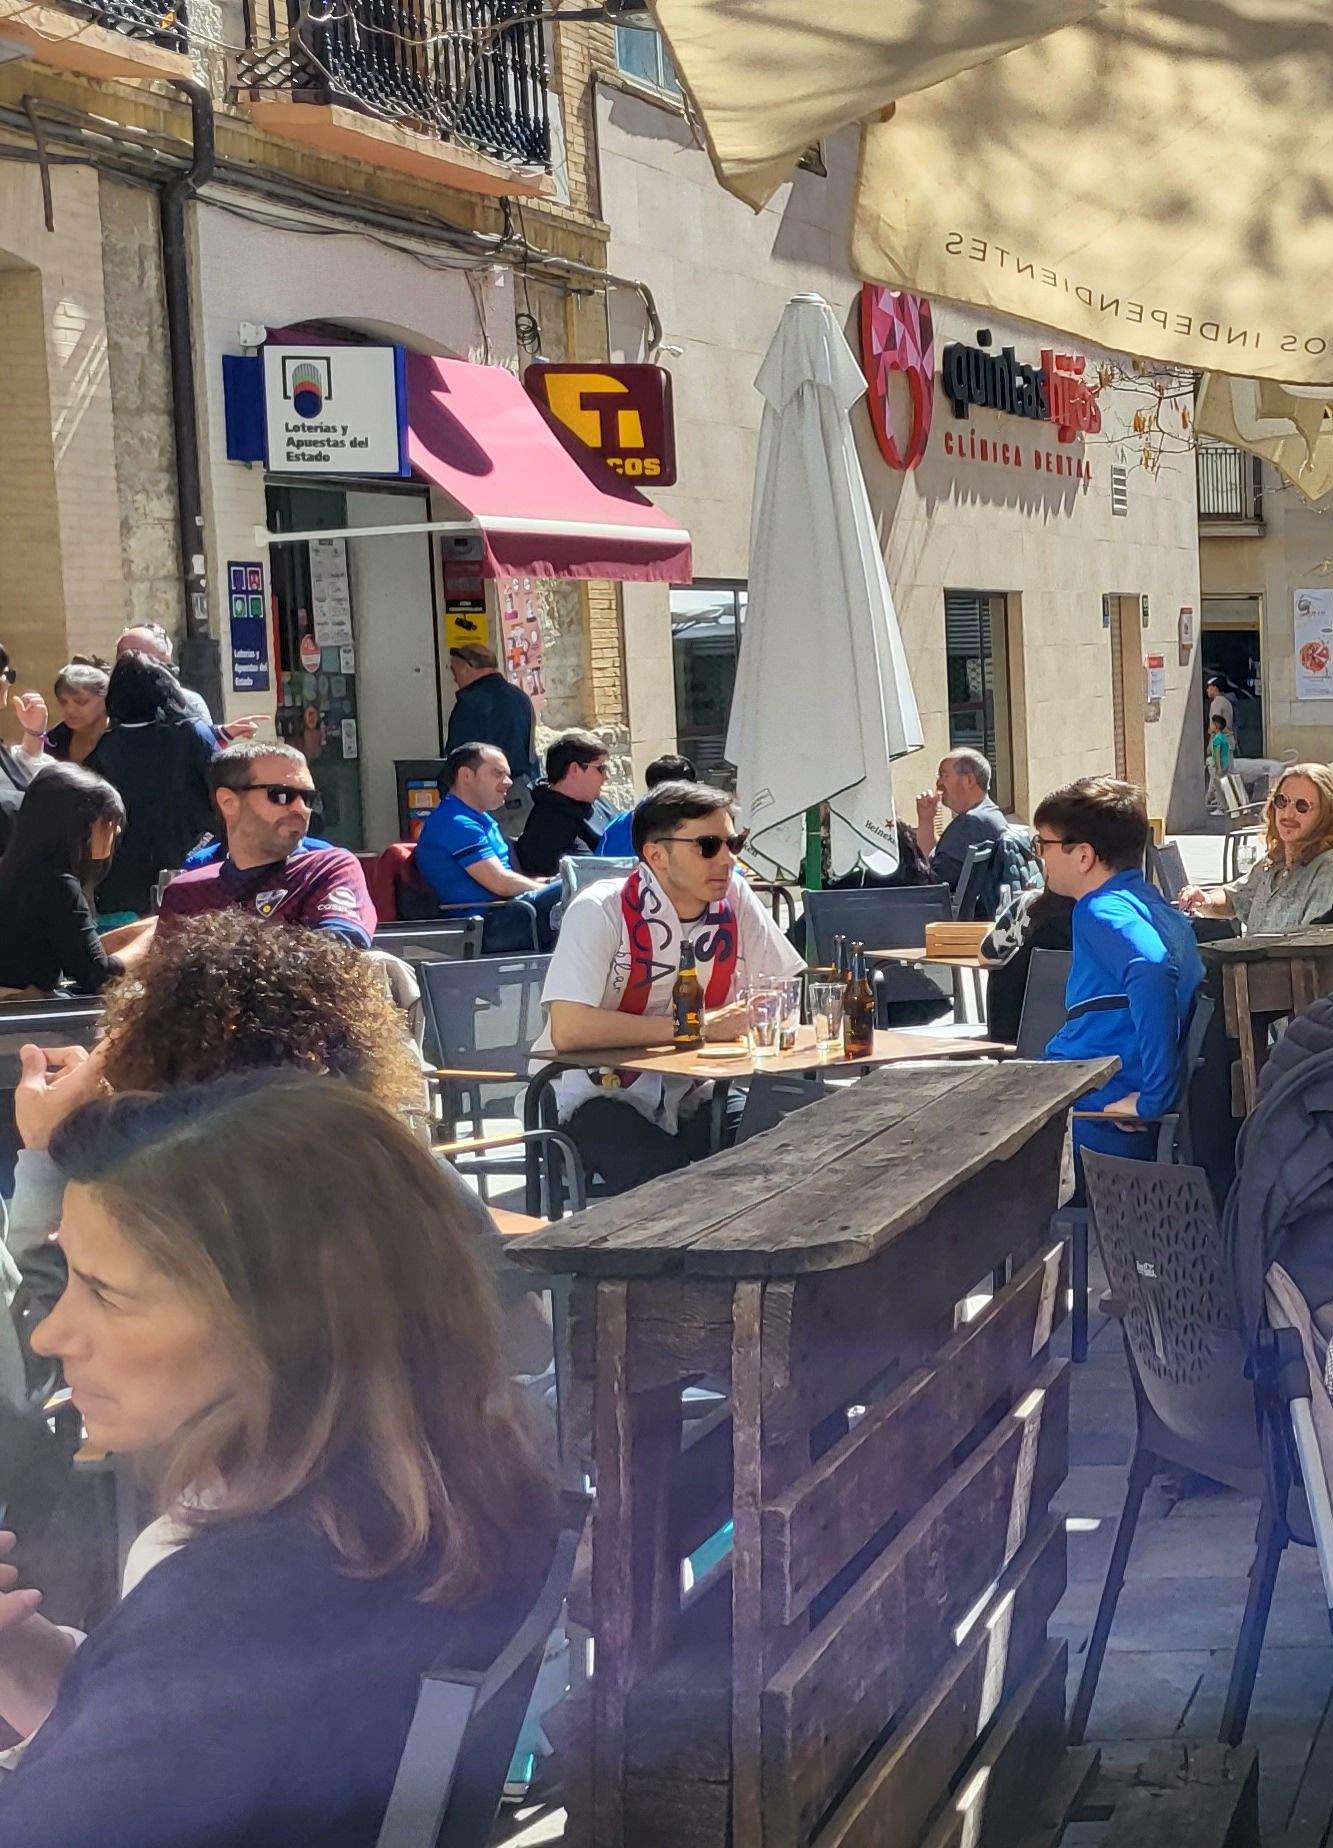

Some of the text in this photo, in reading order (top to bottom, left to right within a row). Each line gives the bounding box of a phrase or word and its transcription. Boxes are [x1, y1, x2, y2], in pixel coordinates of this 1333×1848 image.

[341, 424, 349, 436] y
[286, 437, 369, 450] Apuestas del
[286, 450, 331, 463] Estado
